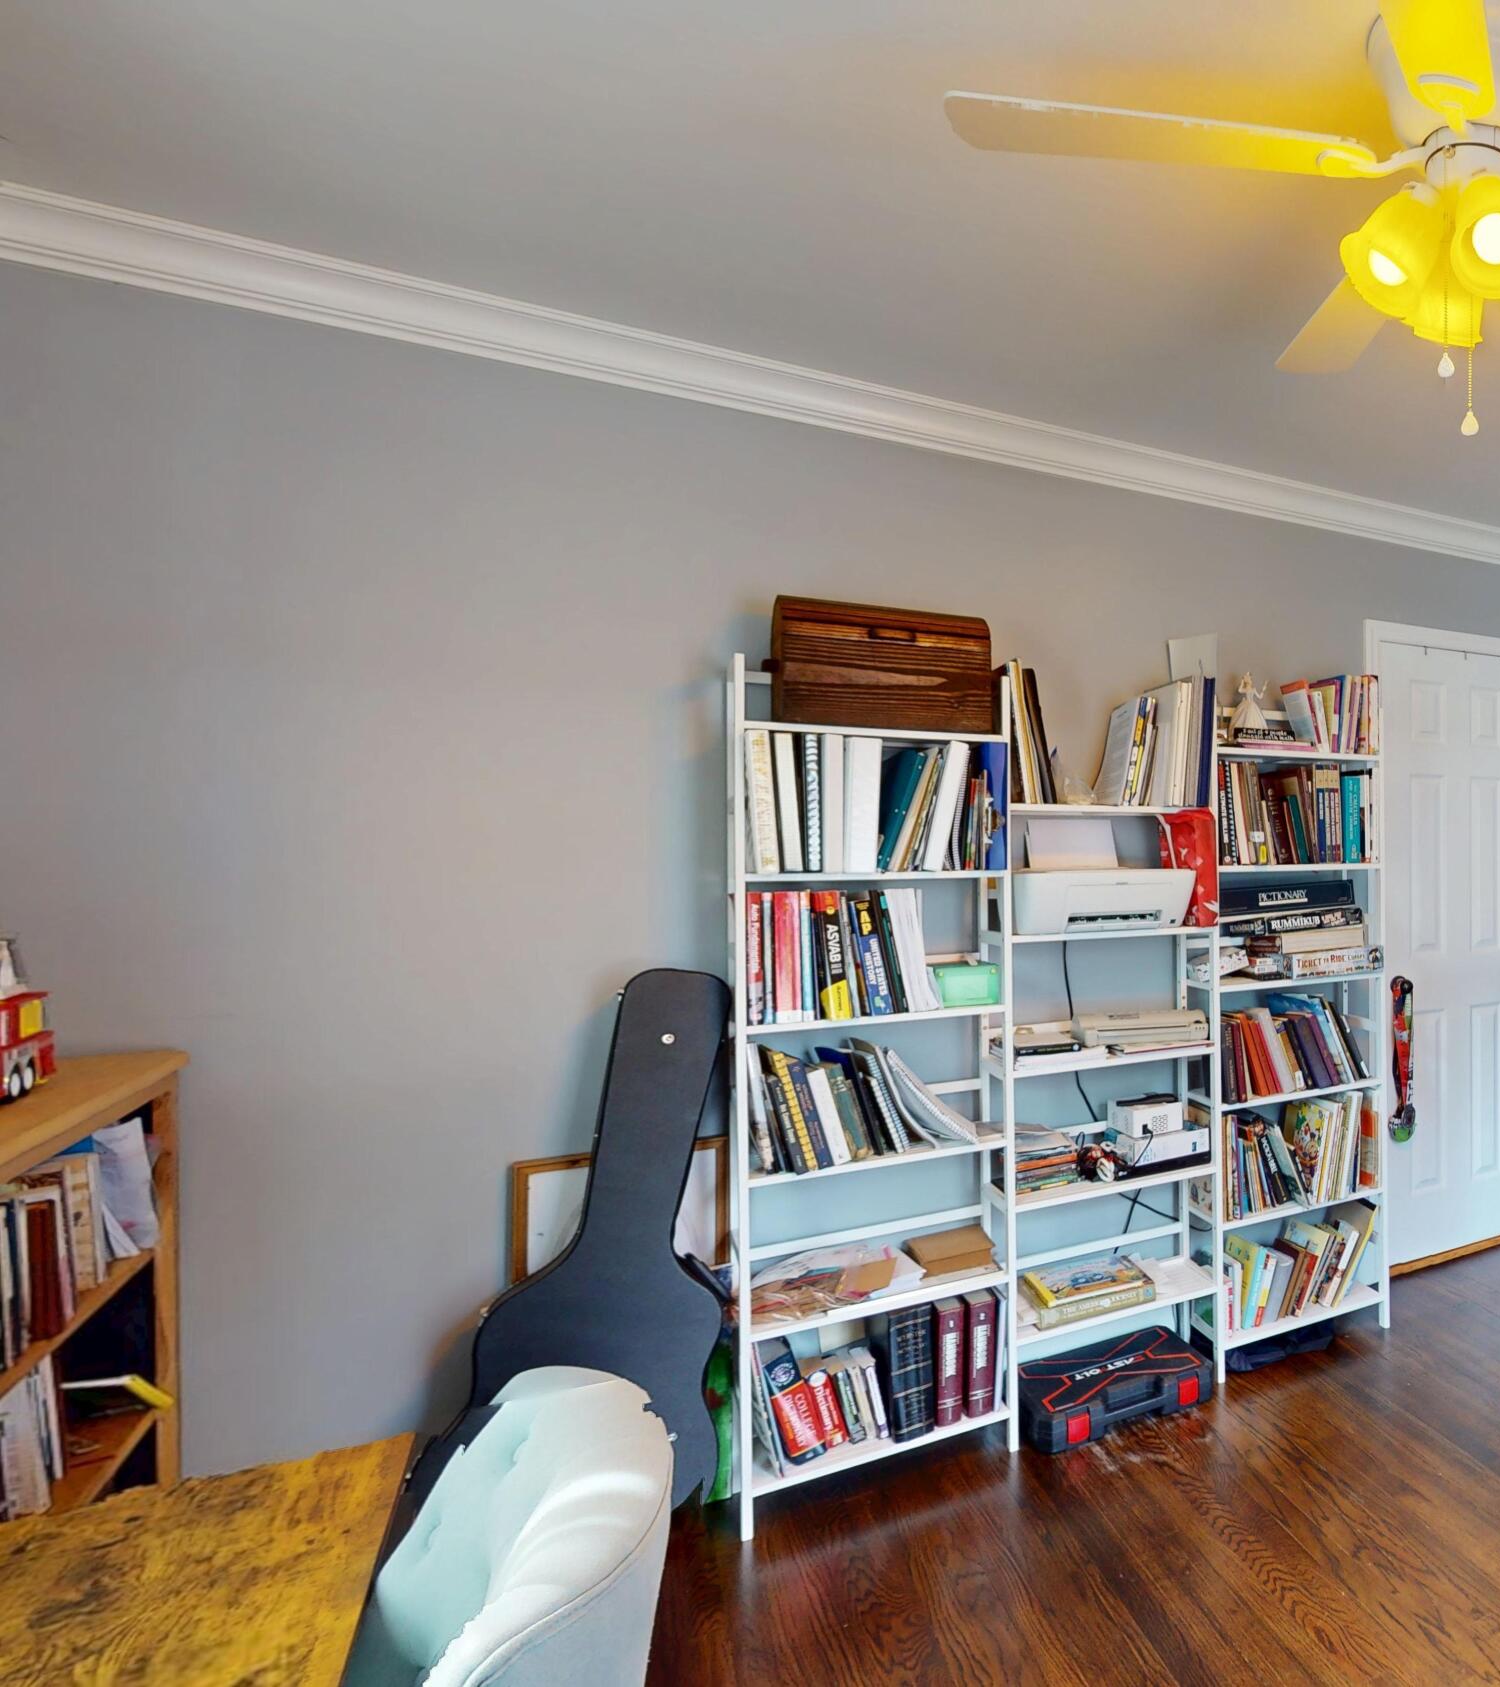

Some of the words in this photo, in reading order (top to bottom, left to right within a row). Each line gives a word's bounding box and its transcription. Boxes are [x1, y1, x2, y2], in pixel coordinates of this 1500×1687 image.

[1258, 889, 1307, 902] PICTIONARY
[859, 910, 873, 936] AP
[1271, 914, 1320, 930] RUMMIKUB
[825, 923, 842, 964] ASVAB
[869, 938, 882, 967] UNITED
[864, 952, 877, 985] HISTORY
[1296, 956, 1322, 970] TICKET
[1330, 954, 1345, 963] RIDE
[875, 967, 888, 996] STATES
[813, 1386, 833, 1431] Dictionary
